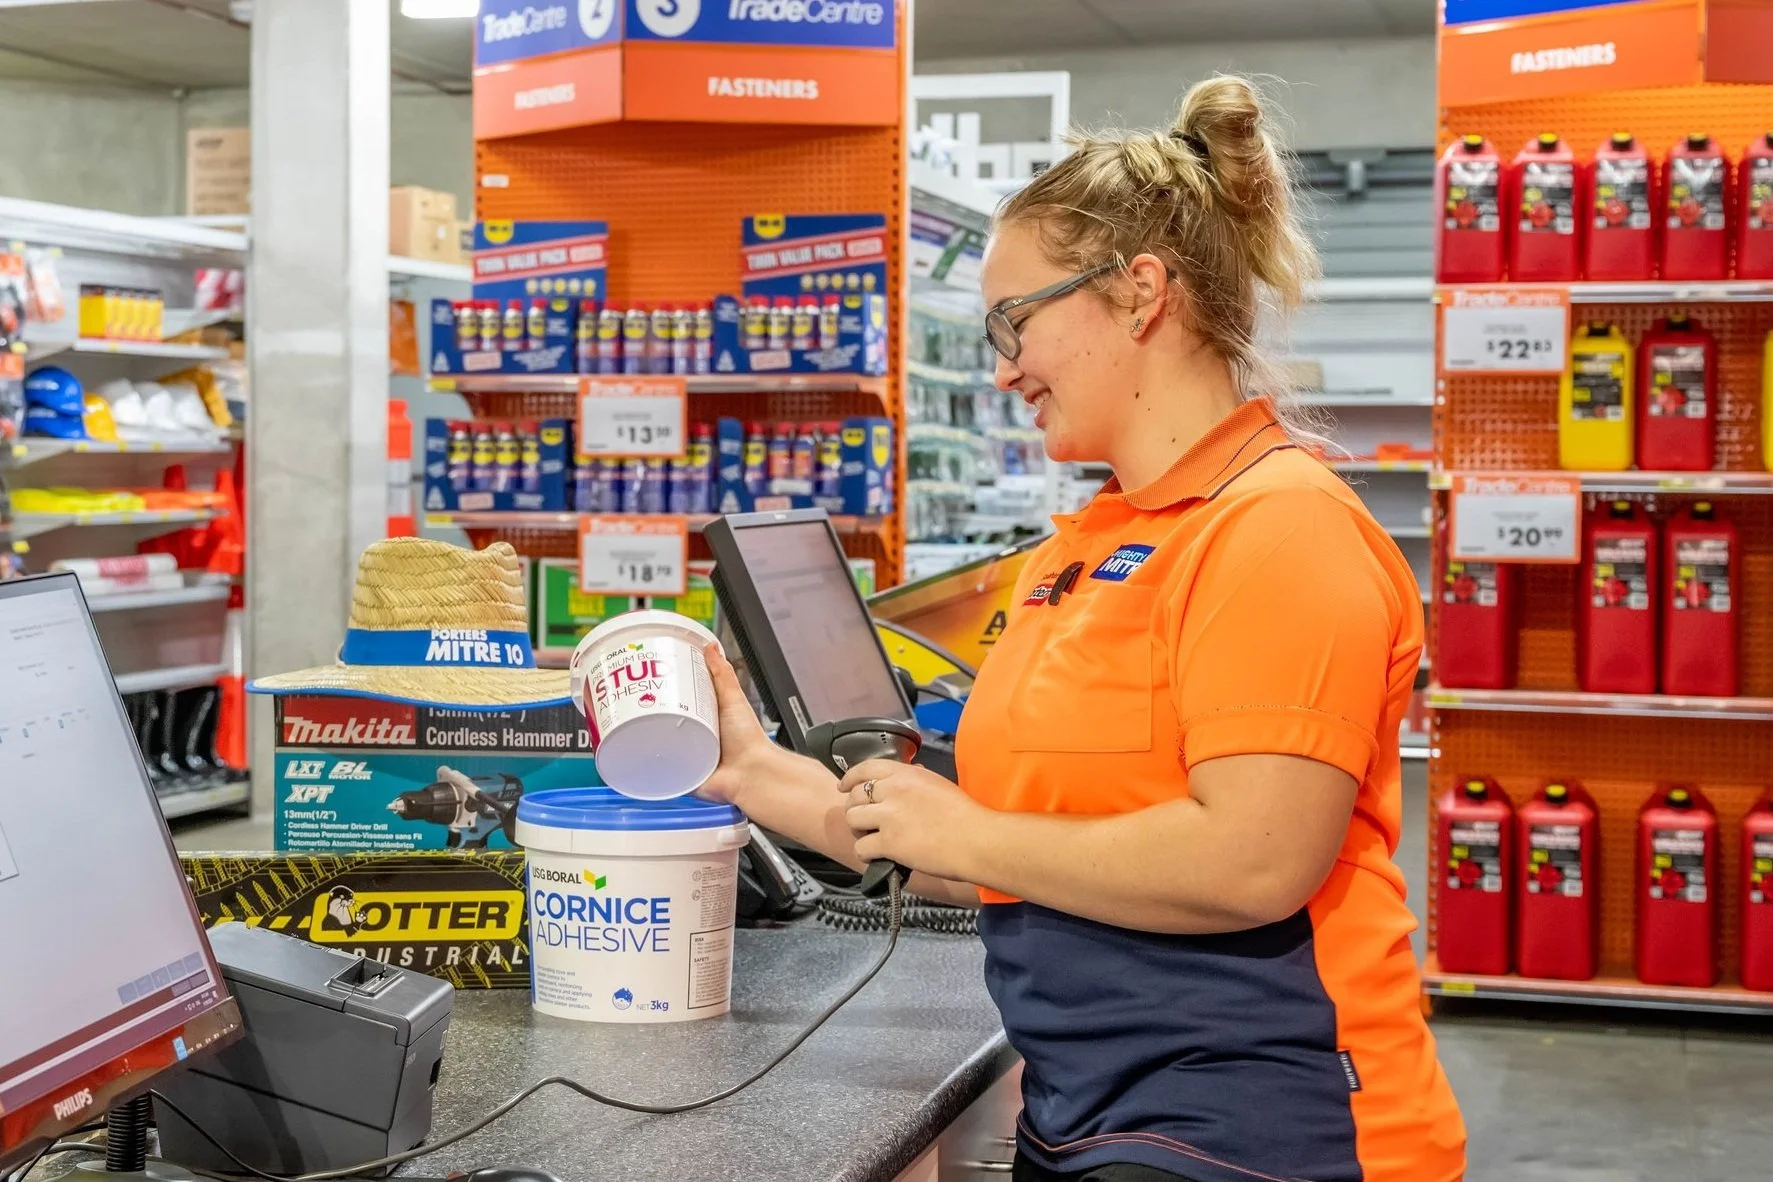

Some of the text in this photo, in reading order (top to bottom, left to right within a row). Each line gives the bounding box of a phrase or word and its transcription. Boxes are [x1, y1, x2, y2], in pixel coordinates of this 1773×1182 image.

[1510, 41, 1616, 74] FASTENERS
[708, 77, 818, 100] FASTENERS
[431, 629, 488, 641] PORTERS
[425, 640, 524, 666] MITRE 10
[606, 647, 628, 661] ORAL
[426, 726, 498, 747] Cordless
[502, 728, 573, 748] Hammer
[284, 760, 326, 779] LXT
[284, 784, 335, 803] XPT
[288, 822, 388, 831] Cordless Hammer Driver Drill
[533, 866, 582, 884] USG BORAL
[360, 901, 511, 931] OTTER
[534, 890, 671, 925] CORNICE
[536, 920, 670, 953] ADHESIVE
[338, 945, 524, 966] DUSTRIAL
[650, 1000, 669, 1012] 3kg
[53, 1087, 93, 1121] PHILIPS
